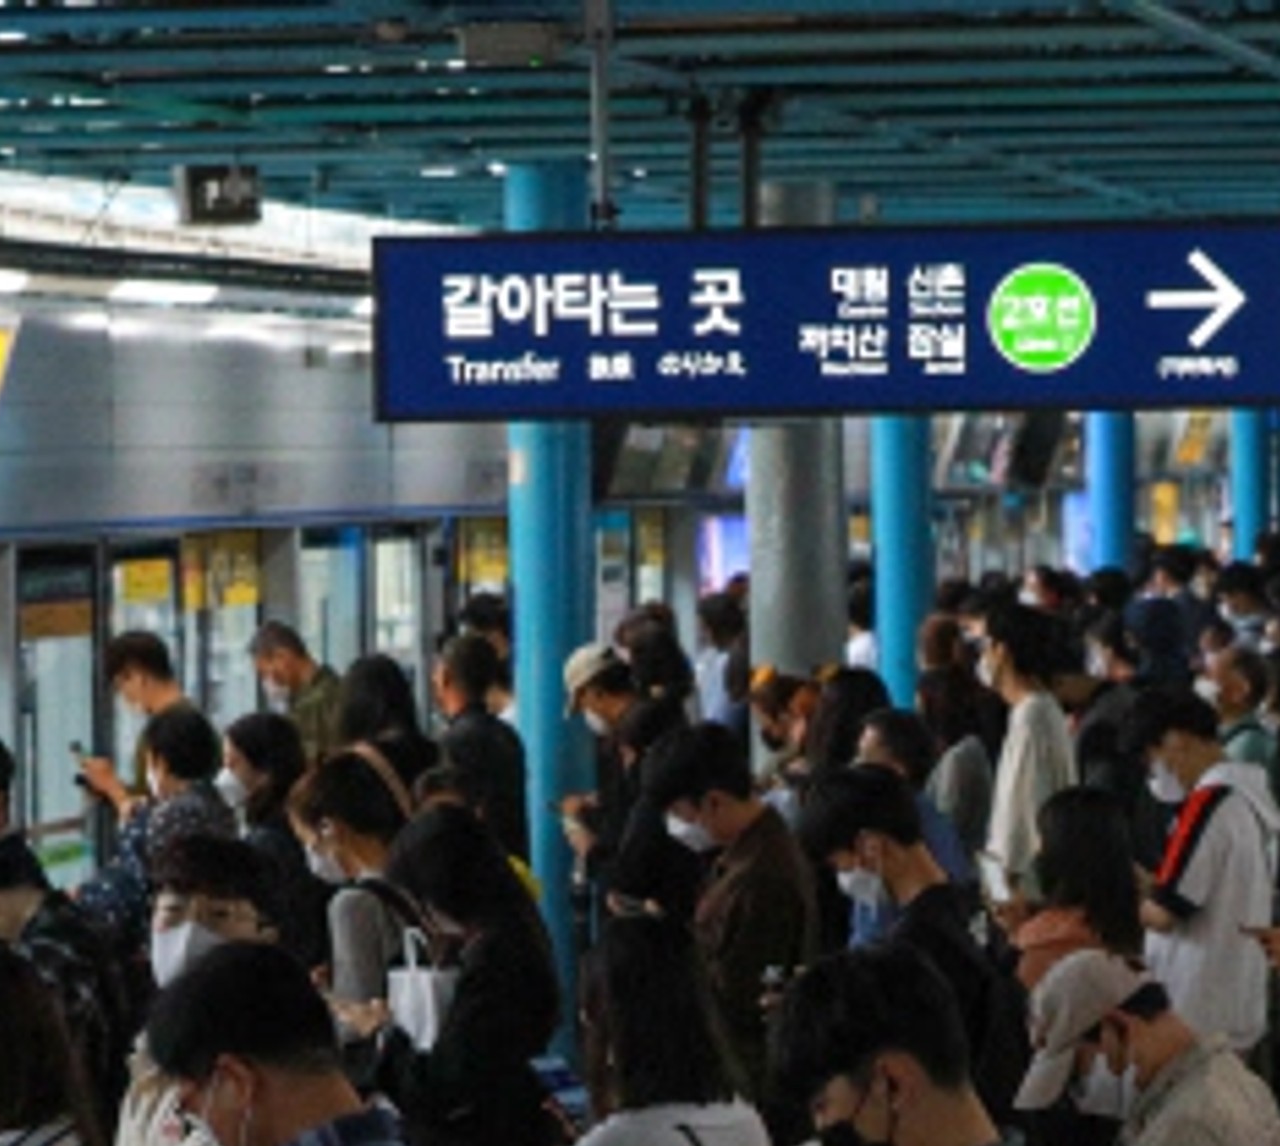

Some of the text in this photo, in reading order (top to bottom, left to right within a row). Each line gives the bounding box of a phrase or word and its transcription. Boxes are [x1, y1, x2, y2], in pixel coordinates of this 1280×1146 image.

[441, 267, 744, 338] 갈아타는 곳
[443, 352, 560, 384] Transfer
